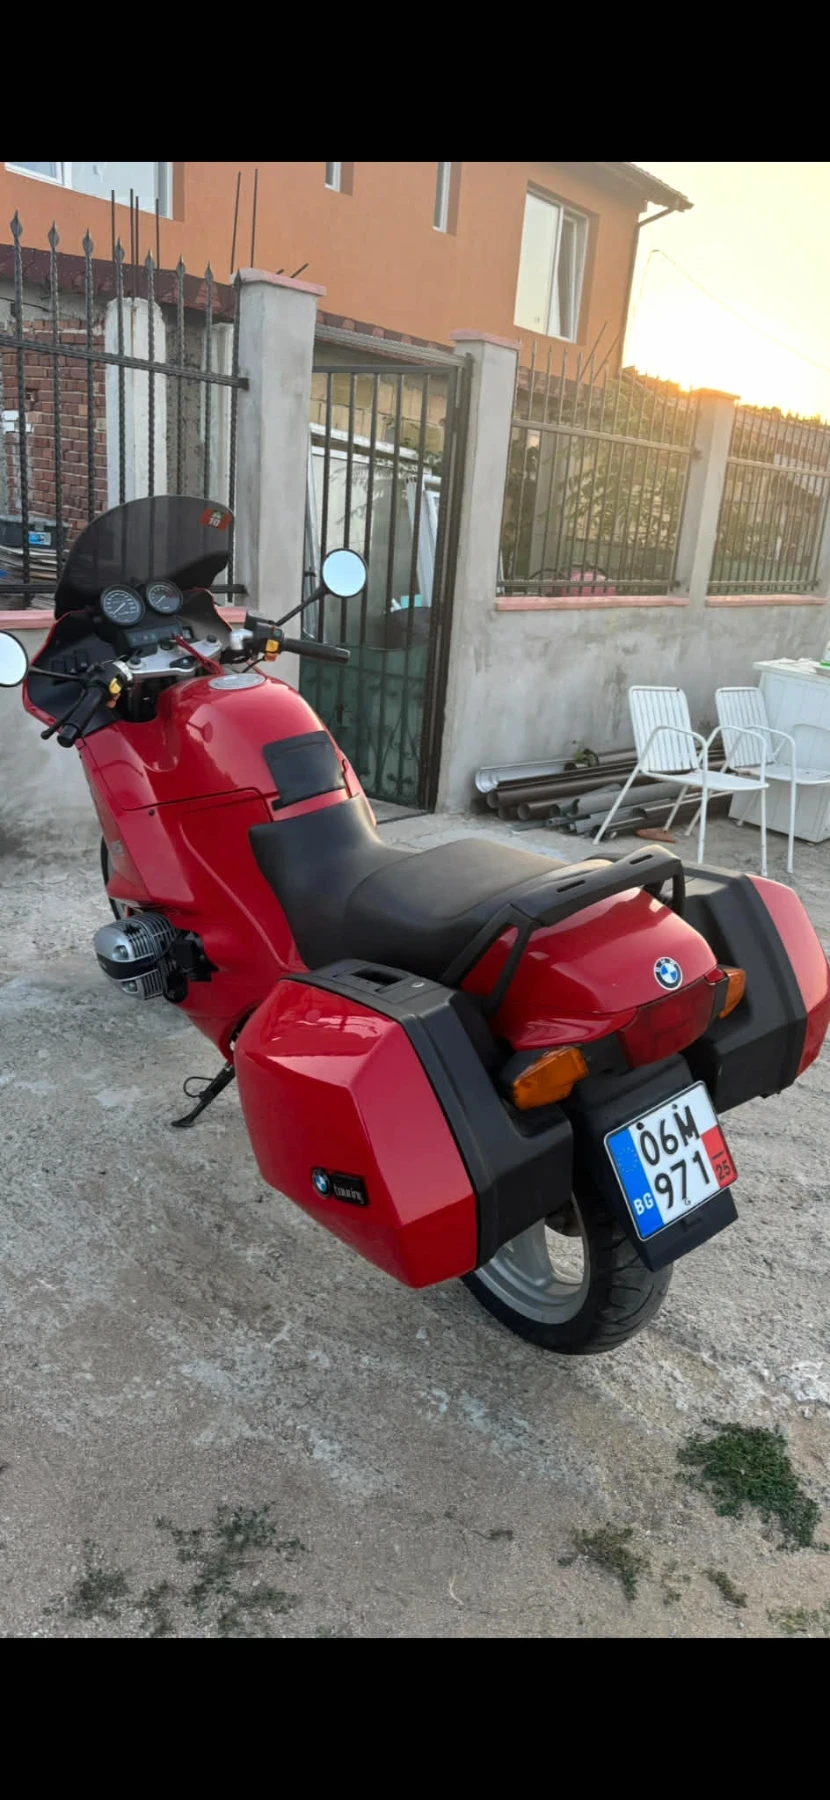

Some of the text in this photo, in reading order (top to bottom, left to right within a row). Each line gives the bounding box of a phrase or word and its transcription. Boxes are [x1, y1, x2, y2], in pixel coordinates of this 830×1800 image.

[654, 1150, 710, 1209] 971
[715, 1159, 731, 1181] 25
[633, 1192, 654, 1216] BG
